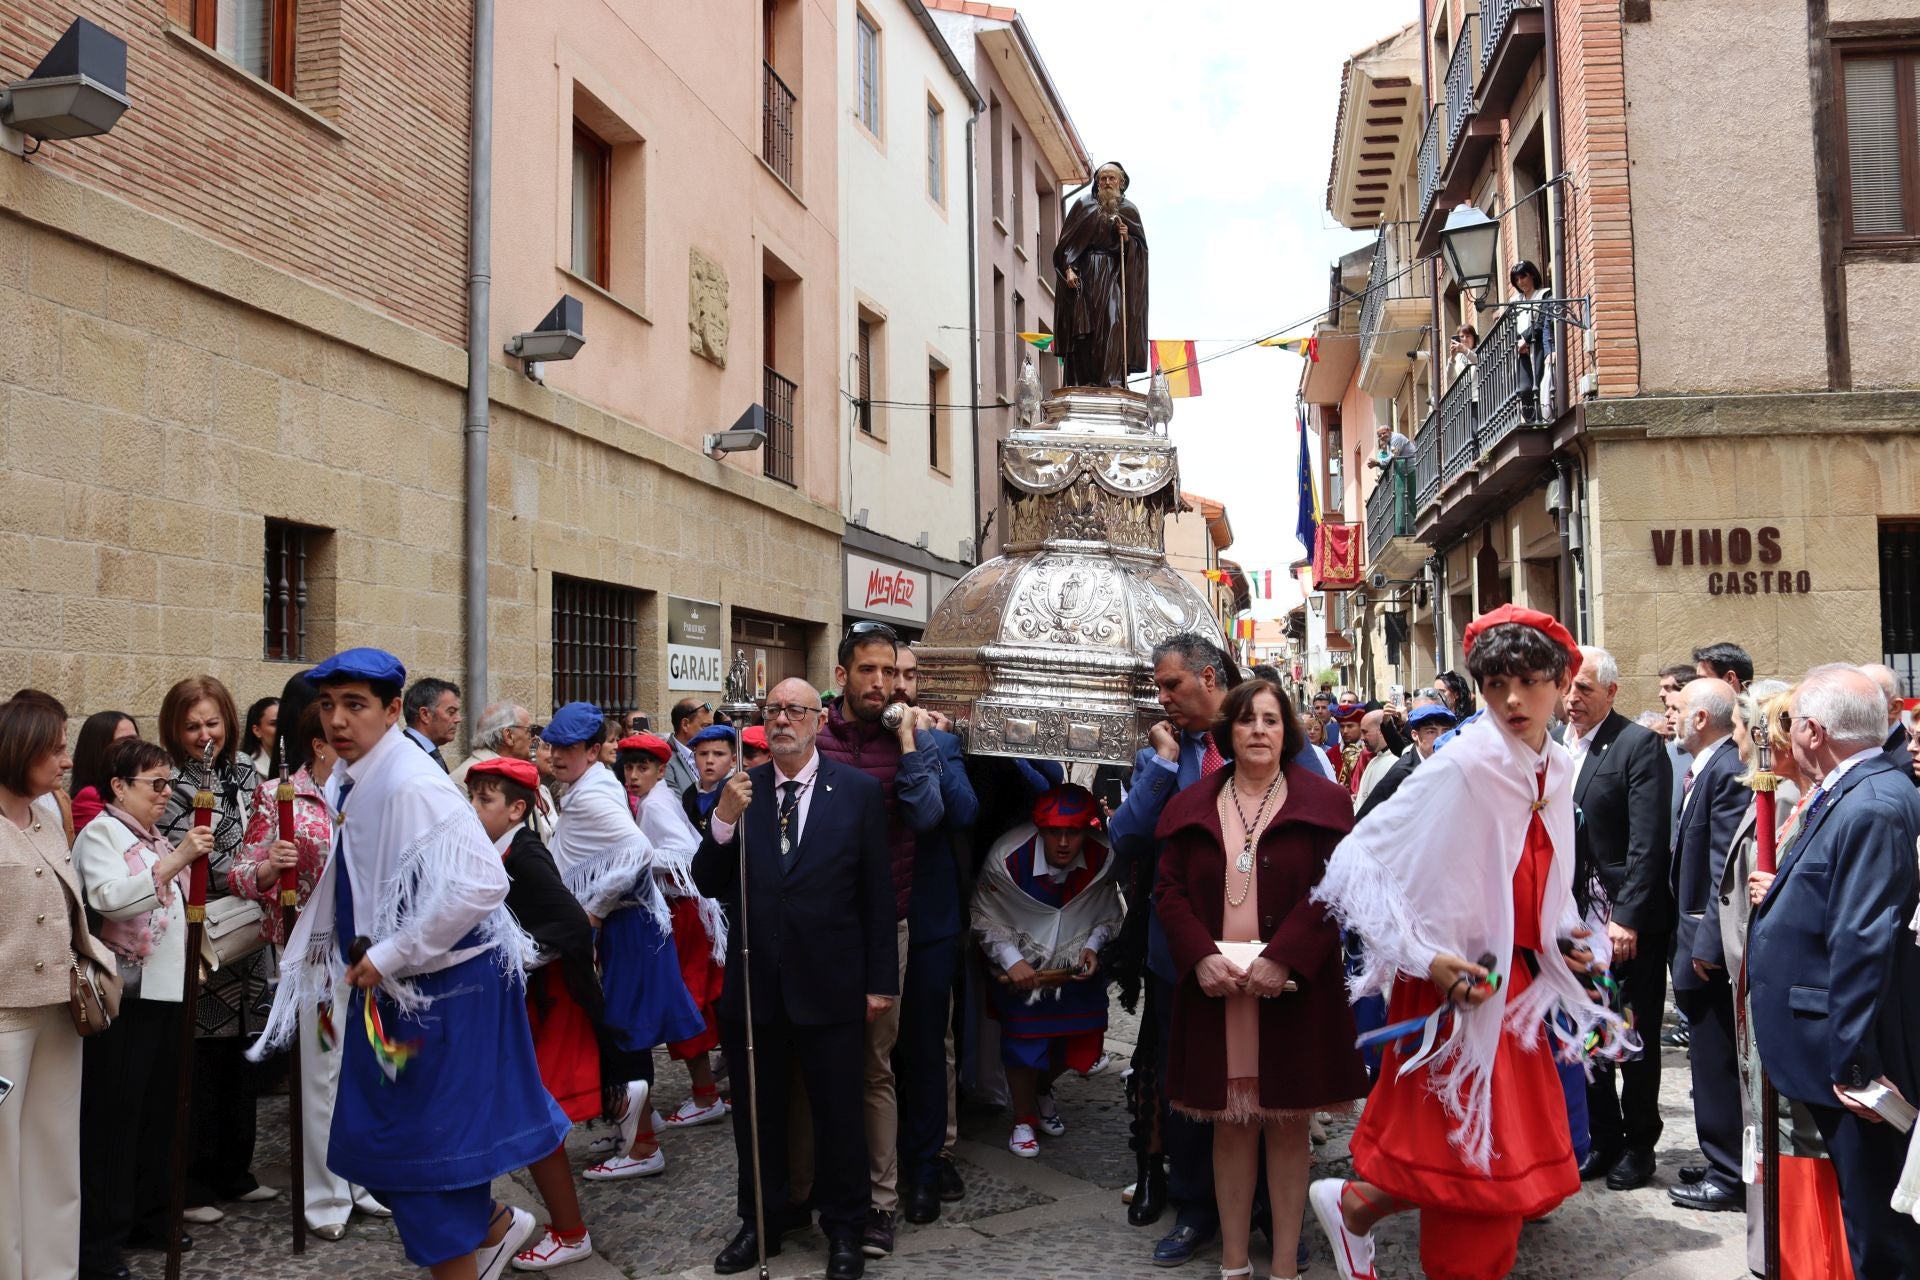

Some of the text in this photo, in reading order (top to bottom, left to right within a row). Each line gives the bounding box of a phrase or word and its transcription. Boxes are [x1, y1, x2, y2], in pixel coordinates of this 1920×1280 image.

[1651, 527, 1782, 566] VINOS
[1709, 570, 1811, 596] CASTRO
[670, 653, 719, 682] GARAJE
